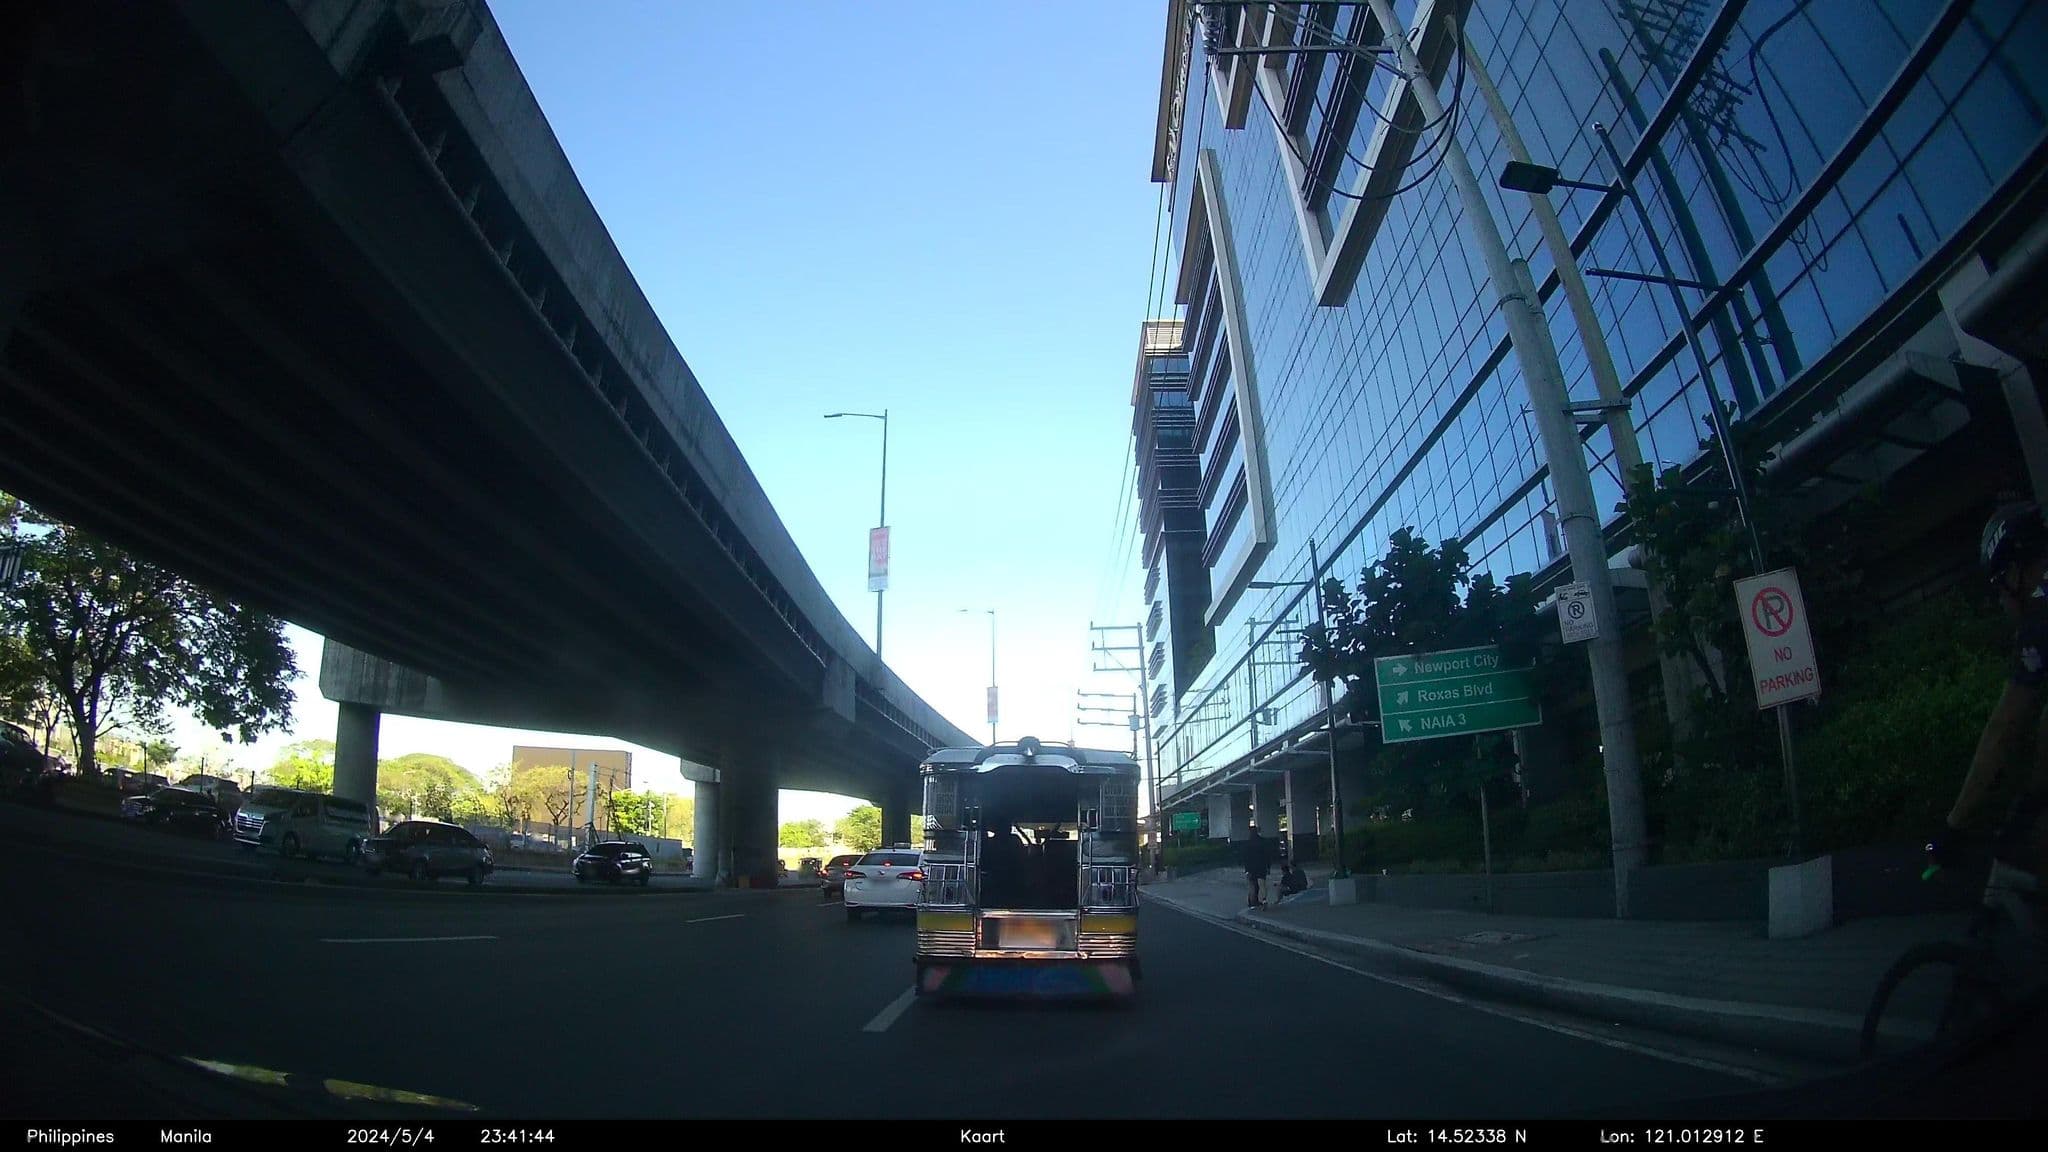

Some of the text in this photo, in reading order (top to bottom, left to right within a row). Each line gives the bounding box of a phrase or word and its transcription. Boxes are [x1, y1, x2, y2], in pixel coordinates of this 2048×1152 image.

[1414, 654, 1499, 674] Newport City
[1774, 646, 1793, 663] NO
[1760, 667, 1814, 694] PARKING
[1417, 682, 1493, 702] Roxas Blvd
[1420, 713, 1467, 730] NAIA 3
